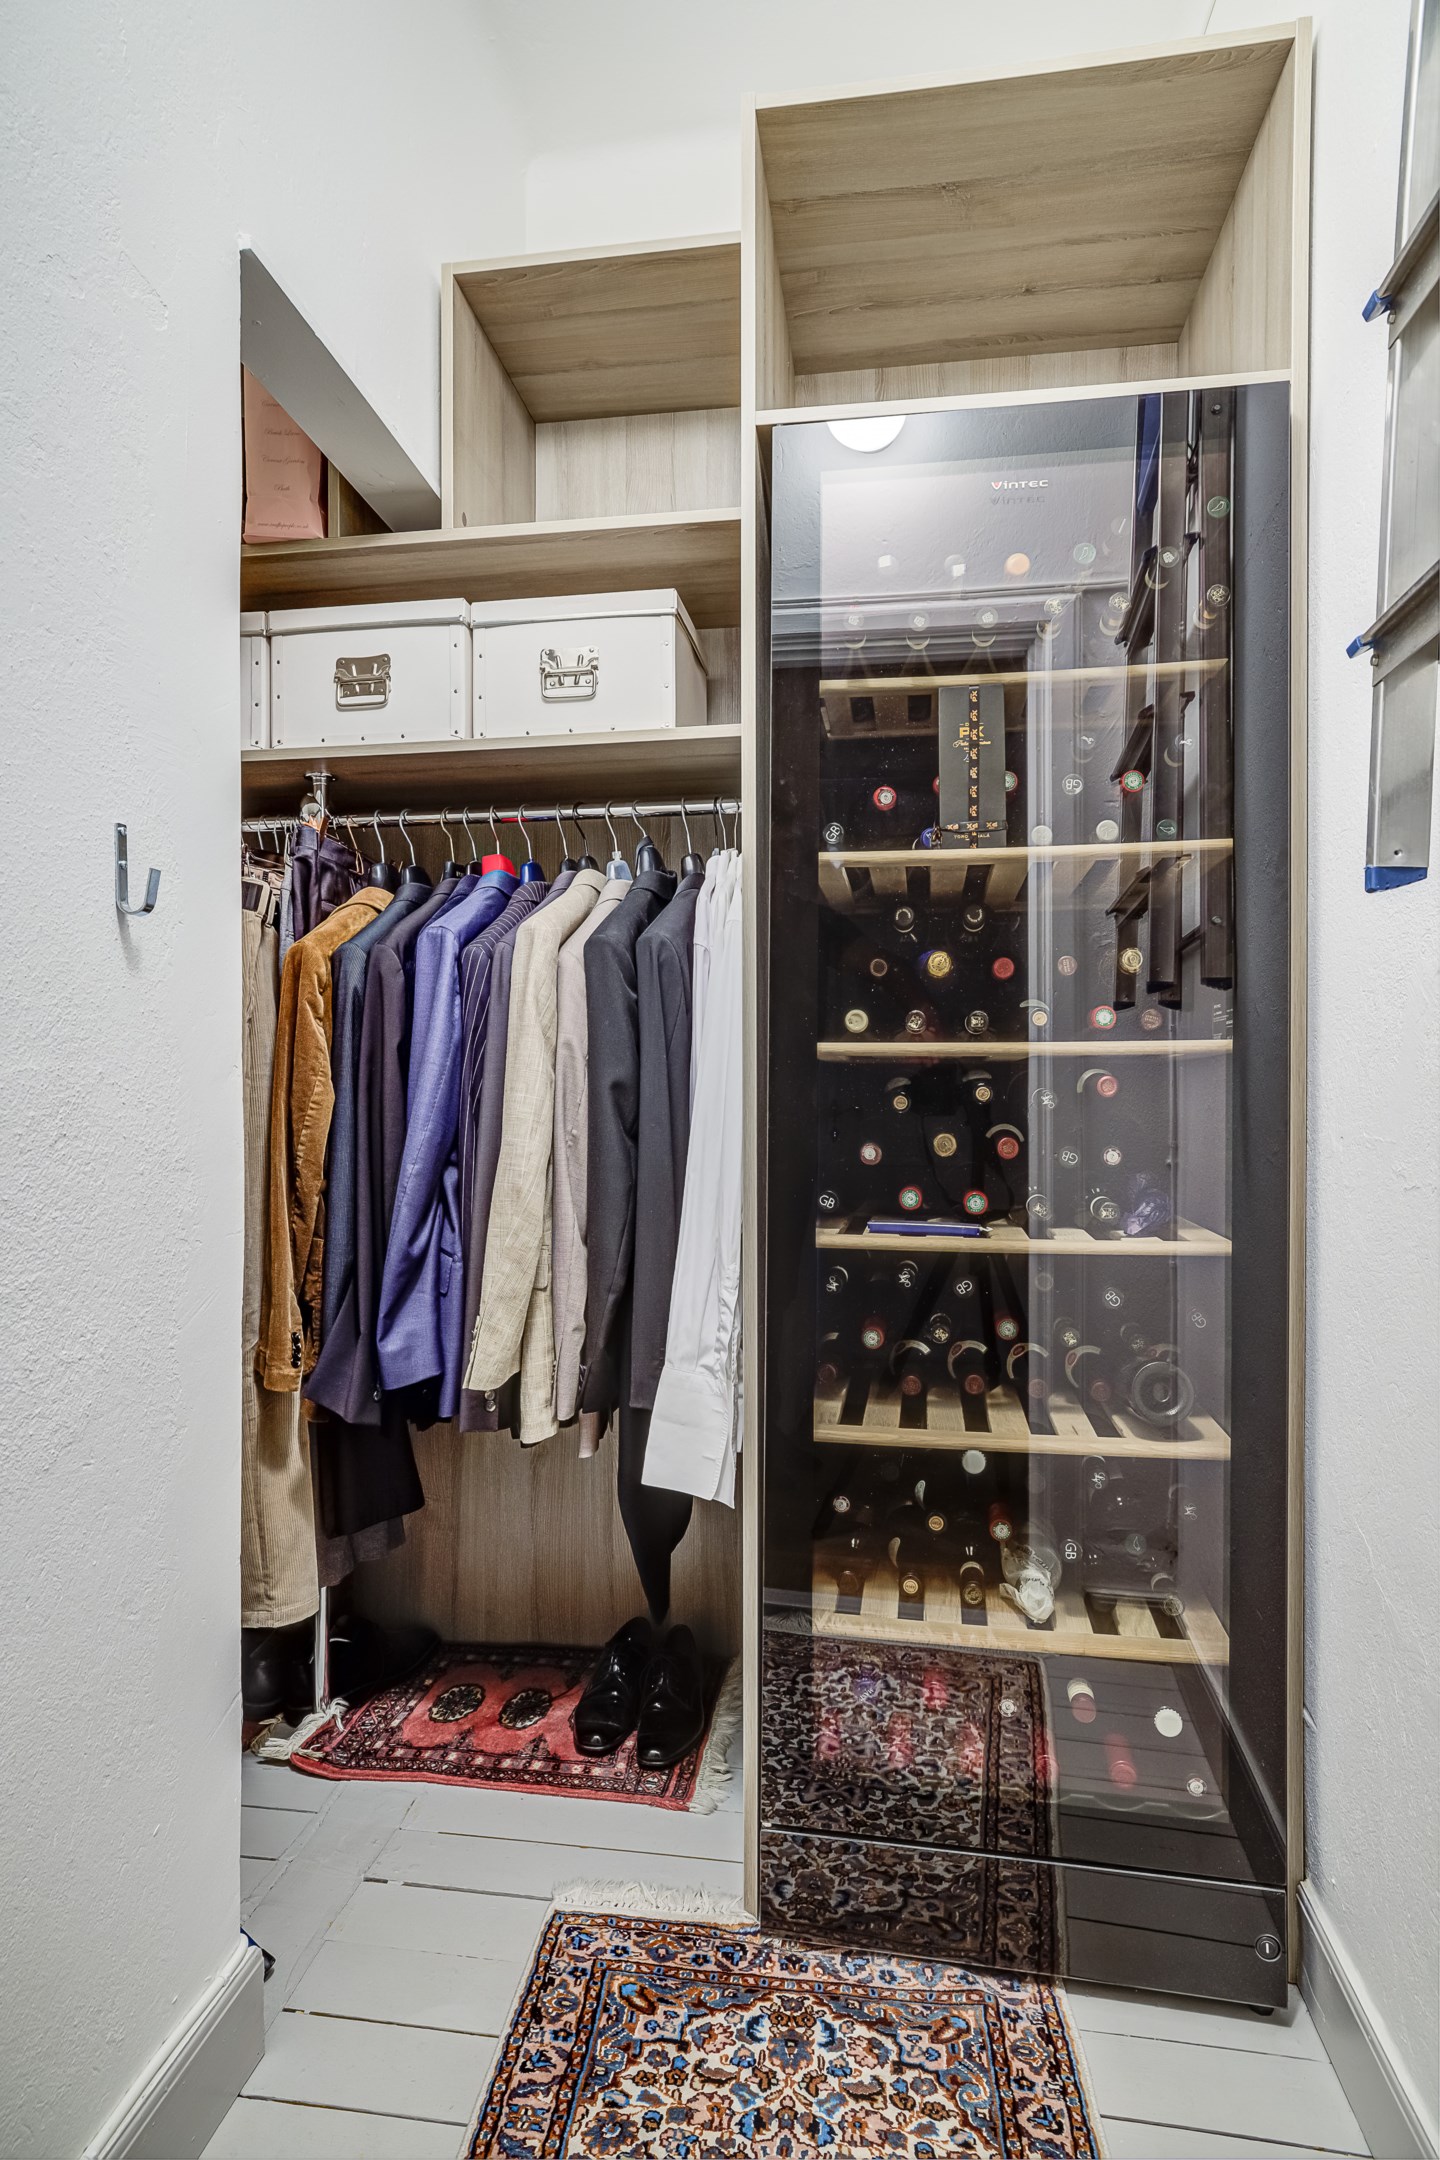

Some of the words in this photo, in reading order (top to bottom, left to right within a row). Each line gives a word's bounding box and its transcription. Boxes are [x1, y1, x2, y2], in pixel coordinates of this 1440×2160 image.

[825, 825, 841, 841] GB
[1062, 1150, 1078, 1164] GB
[819, 1194, 835, 1209] GB
[956, 1280, 973, 1294] GB
[1105, 1290, 1121, 1307] GB
[1191, 1312, 1206, 1328] GB
[1065, 1542, 1077, 1559] GB
